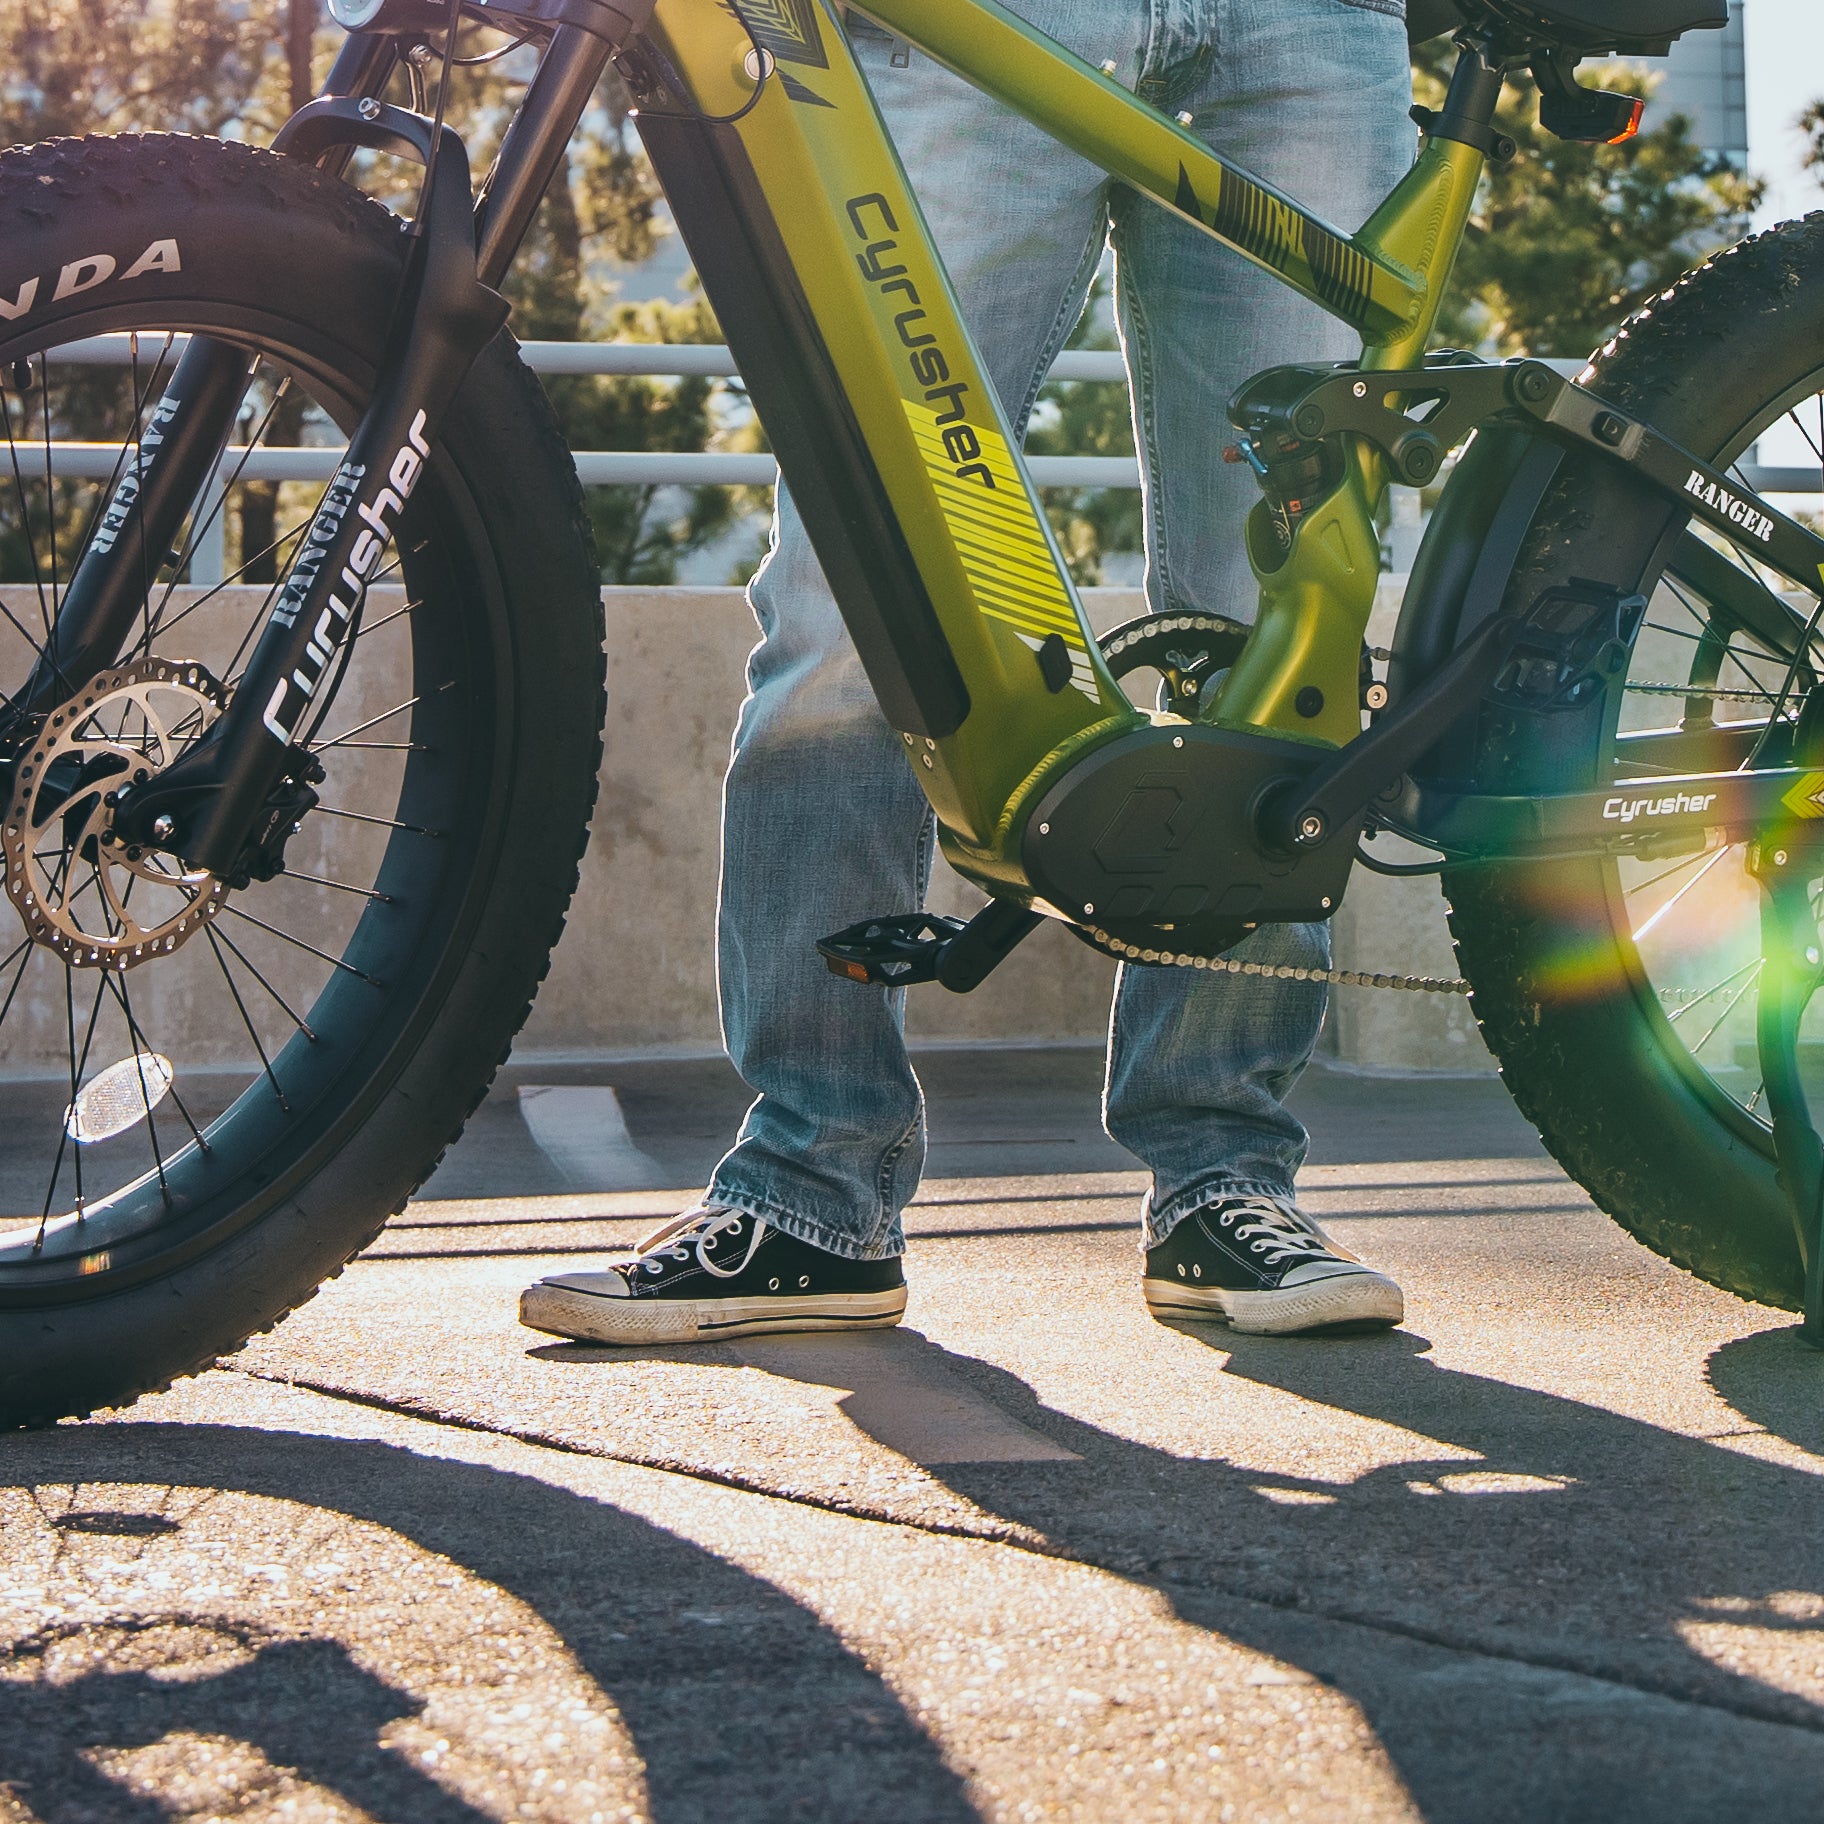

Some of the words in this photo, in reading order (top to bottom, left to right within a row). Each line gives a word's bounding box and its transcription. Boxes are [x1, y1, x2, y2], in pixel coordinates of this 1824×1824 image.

[845, 192, 996, 489] Cyrusher
[269, 461, 367, 629] RANGER
[1683, 469, 1774, 542] RANGER
[1602, 792, 1717, 823] Cyrusher
